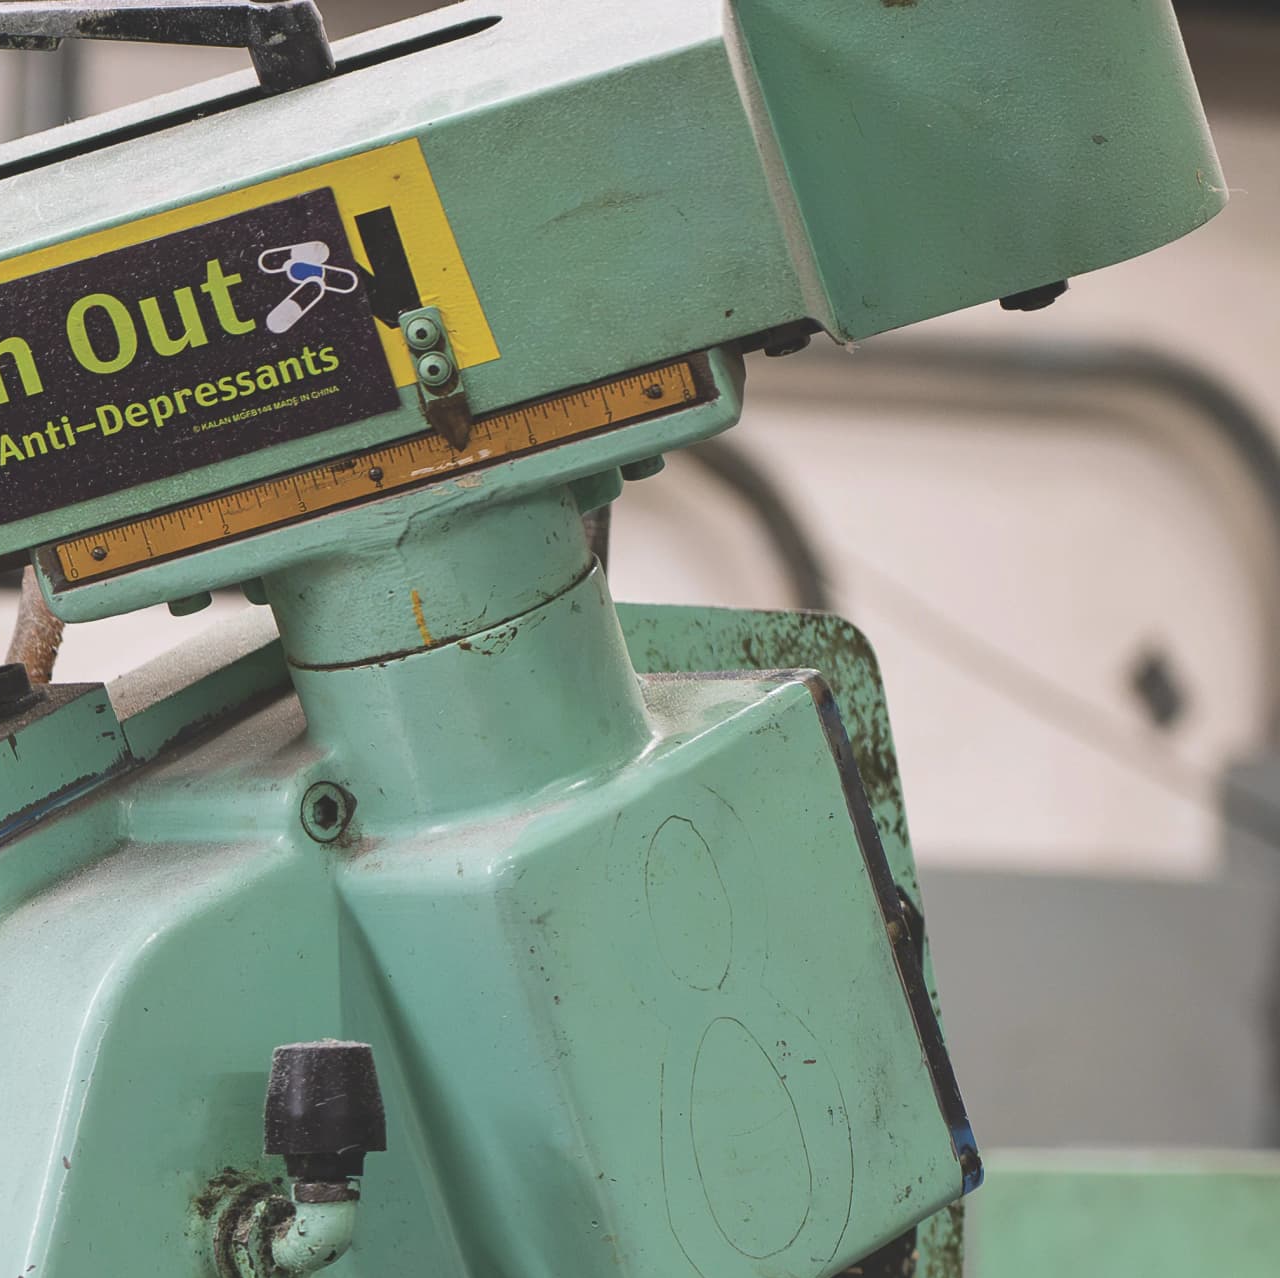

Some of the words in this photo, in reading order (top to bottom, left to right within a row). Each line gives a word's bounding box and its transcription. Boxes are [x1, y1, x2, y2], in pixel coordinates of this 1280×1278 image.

[66, 258, 257, 375] Out
[0, 345, 340, 467] Anti-Depressants
[201, 416, 232, 431] KALAN
[273, 395, 299, 411] MADE
[300, 392, 310, 403] IN
[311, 385, 340, 399] CHINA
[70, 567, 79, 579] 0
[222, 523, 231, 536] 2
[298, 501, 308, 513] 3
[375, 478, 384, 489] 4
[529, 434, 538, 446] 6
[605, 411, 614, 424] 7
